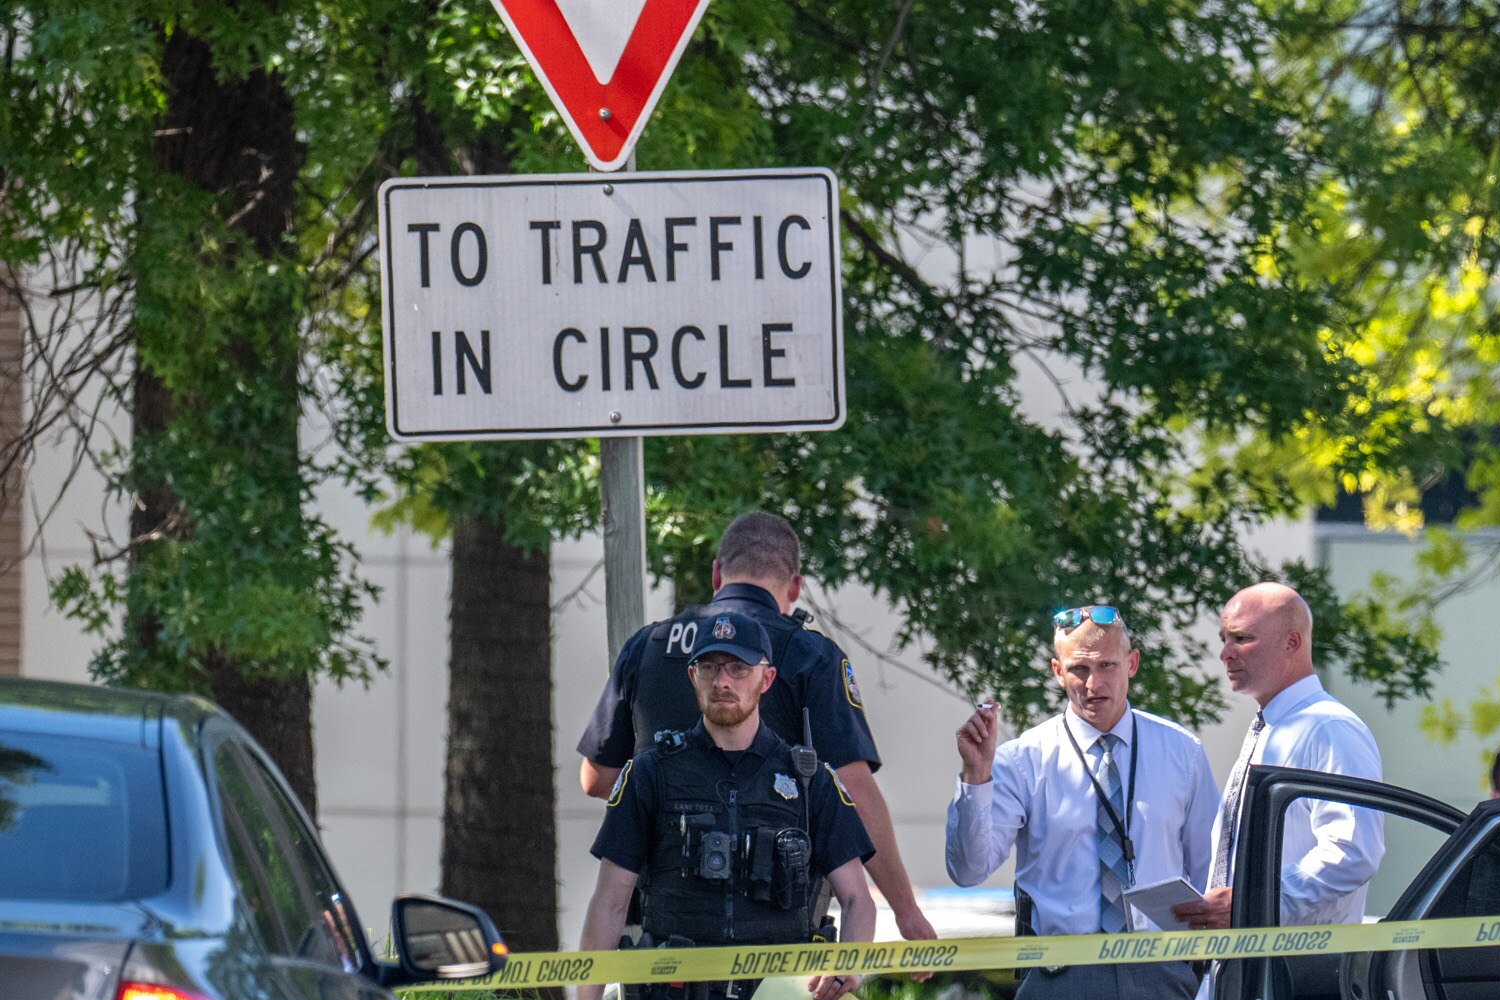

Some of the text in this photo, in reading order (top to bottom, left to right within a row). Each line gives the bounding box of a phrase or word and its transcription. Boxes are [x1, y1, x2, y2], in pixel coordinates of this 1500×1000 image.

[408, 215, 812, 287] TO TRAFFIC
[432, 323, 795, 396] IN CIRCLE
[666, 622, 698, 653] PO
